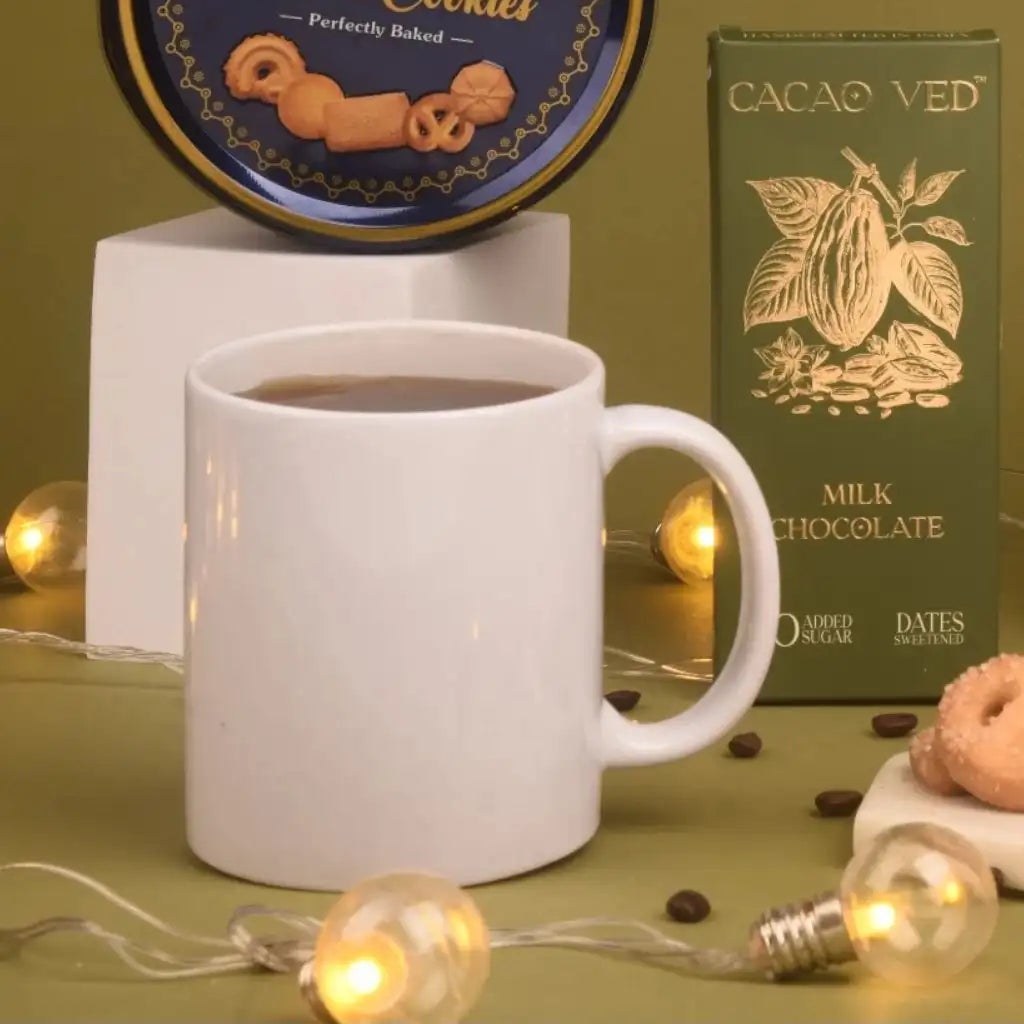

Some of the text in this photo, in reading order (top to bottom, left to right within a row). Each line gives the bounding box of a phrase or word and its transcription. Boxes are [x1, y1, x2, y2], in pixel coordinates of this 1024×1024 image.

[308, 12, 444, 44] Perfectly Baked
[728, 80, 872, 112] CACAO
[822, 483, 892, 505] MILK
[771, 516, 945, 541] CHOCOLATE
[803, 613, 853, 629] ADDED
[897, 611, 965, 634] DATES
[801, 629, 853, 644] SUGAR
[894, 634, 964, 647] SWEETENED
